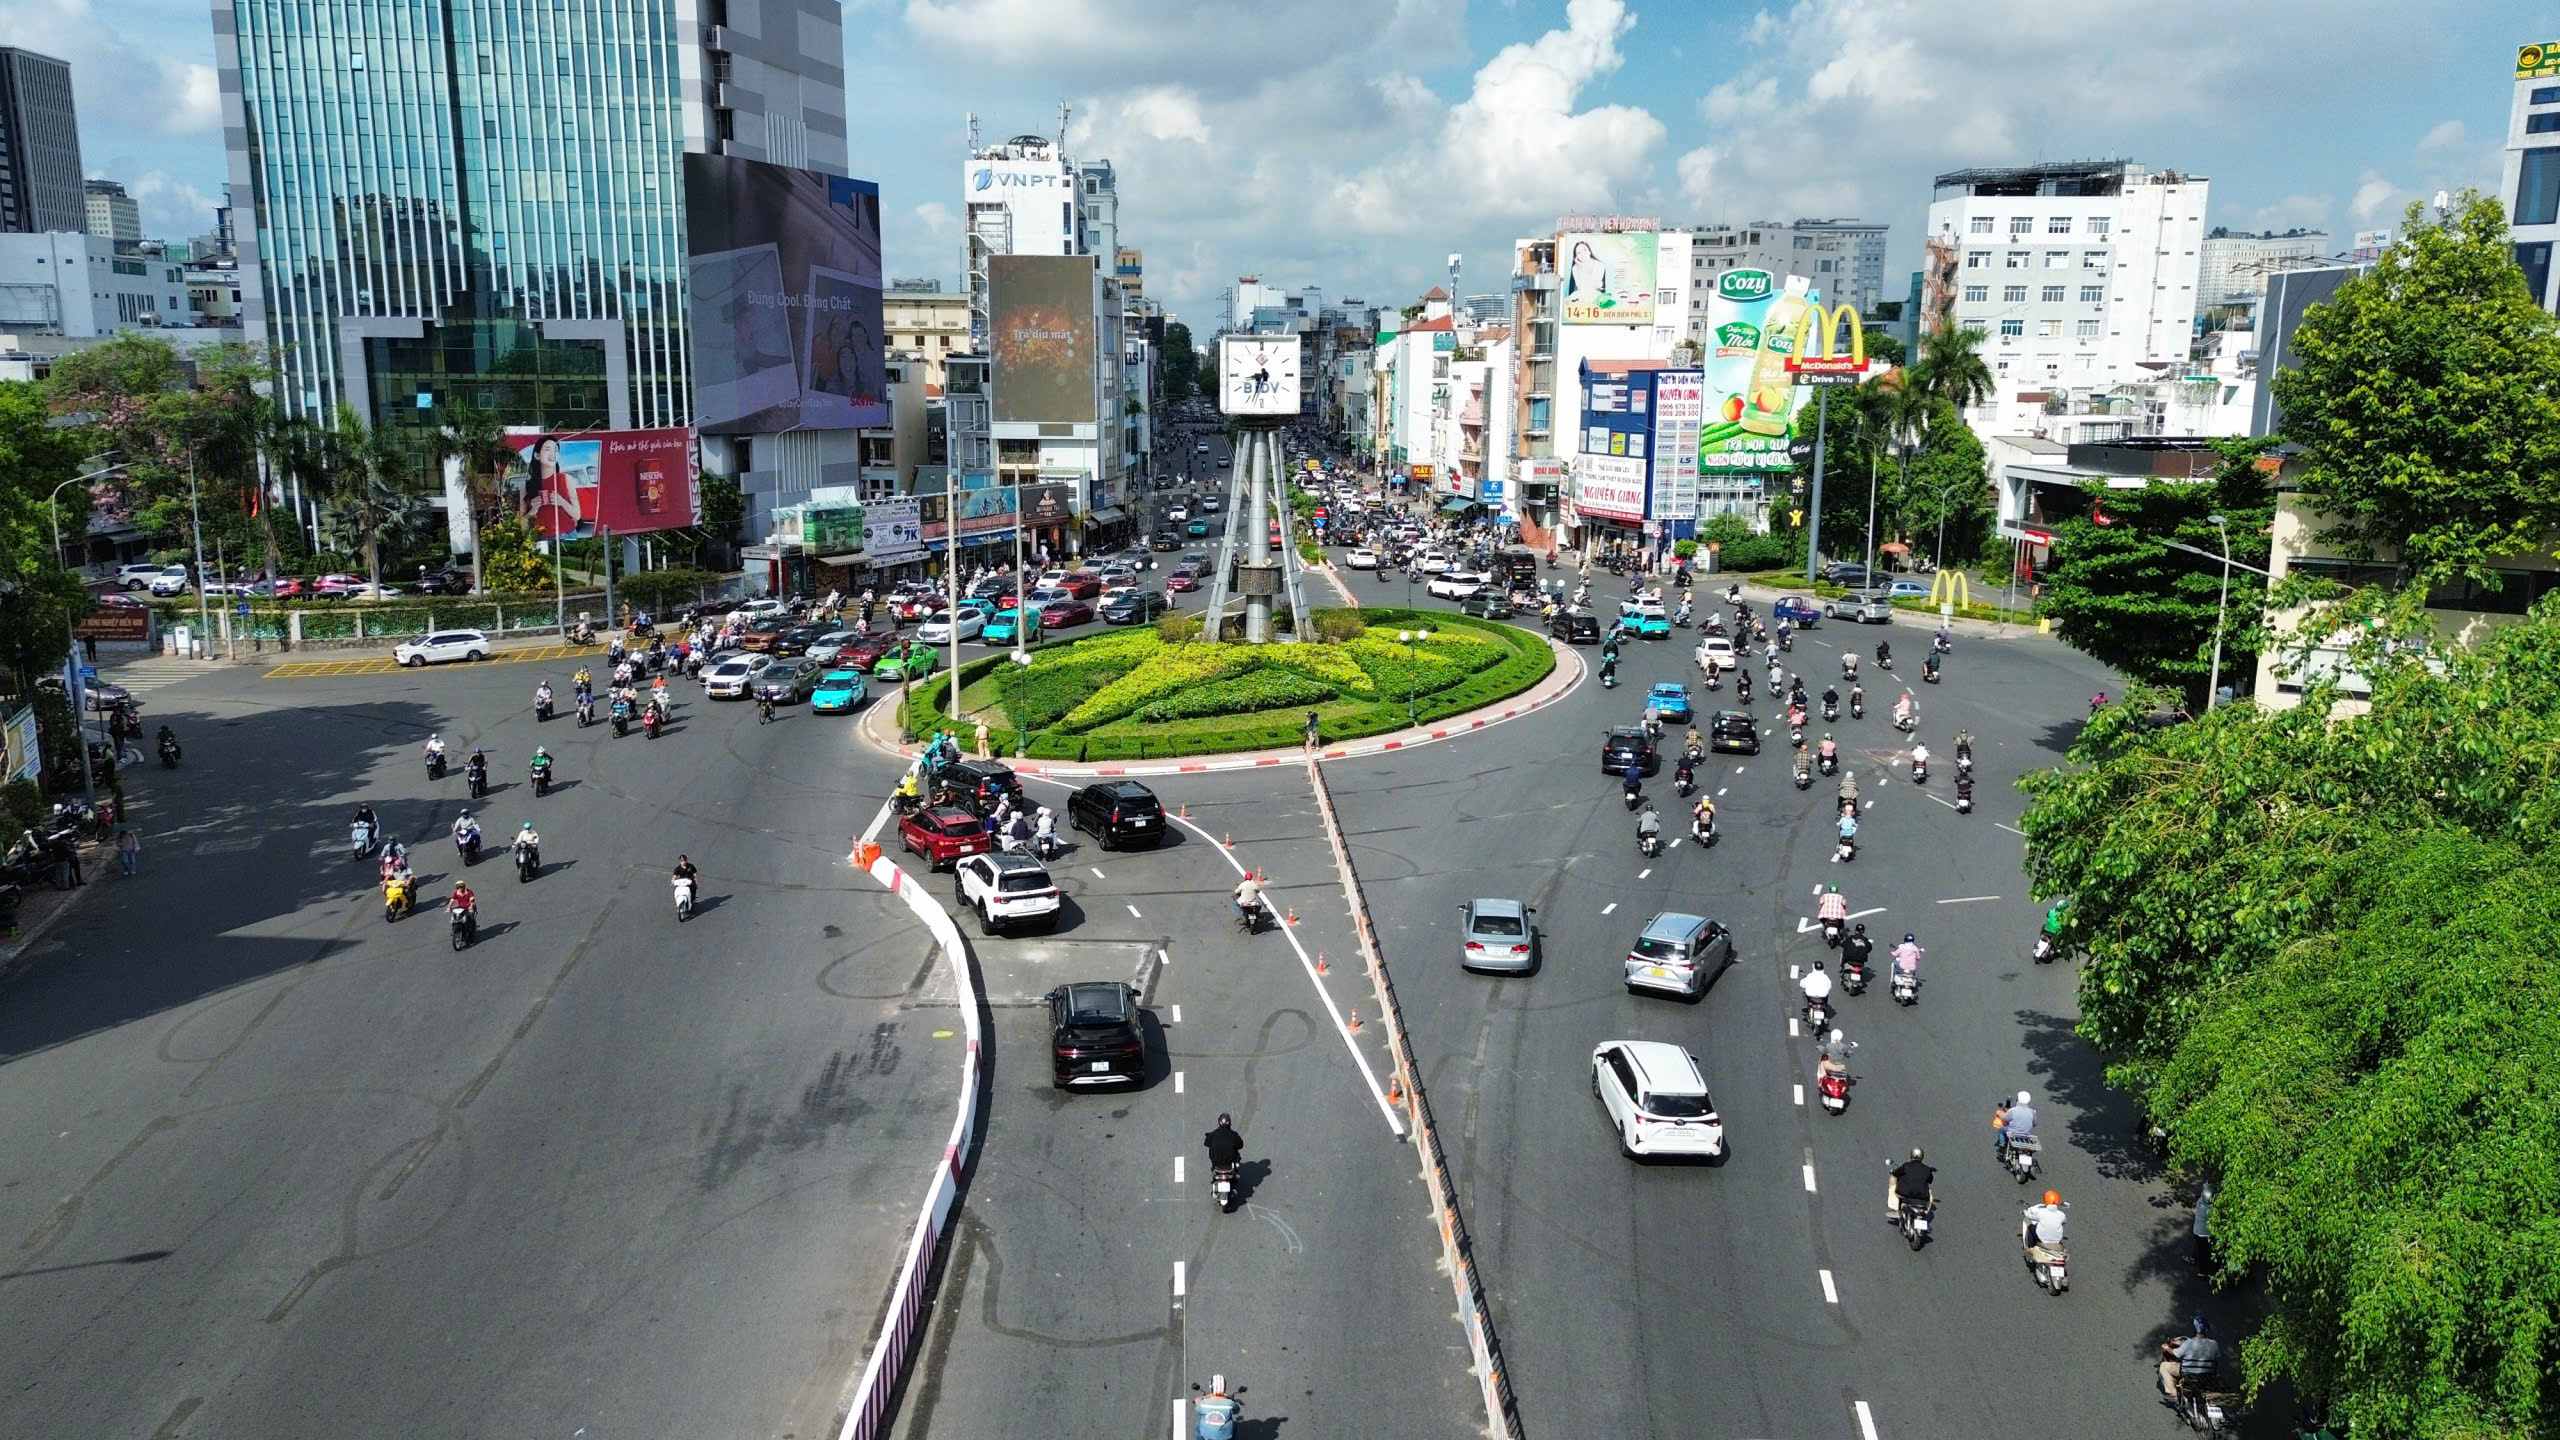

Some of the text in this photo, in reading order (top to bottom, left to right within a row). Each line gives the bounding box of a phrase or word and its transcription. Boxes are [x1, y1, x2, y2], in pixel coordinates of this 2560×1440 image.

[997, 173, 1057, 187] VNPT
[1723, 274, 1766, 293] Cozy
[748, 290, 775, 308] Đúng
[830, 295, 852, 311] Chất
[1568, 307, 1600, 318] 14-16
[1013, 328, 1029, 339] Trà
[1801, 361, 1853, 370] McDonald's
[1811, 375, 1853, 383] Drive Thru
[908, 506, 920, 515] 7K
[904, 529, 918, 541] 7K
